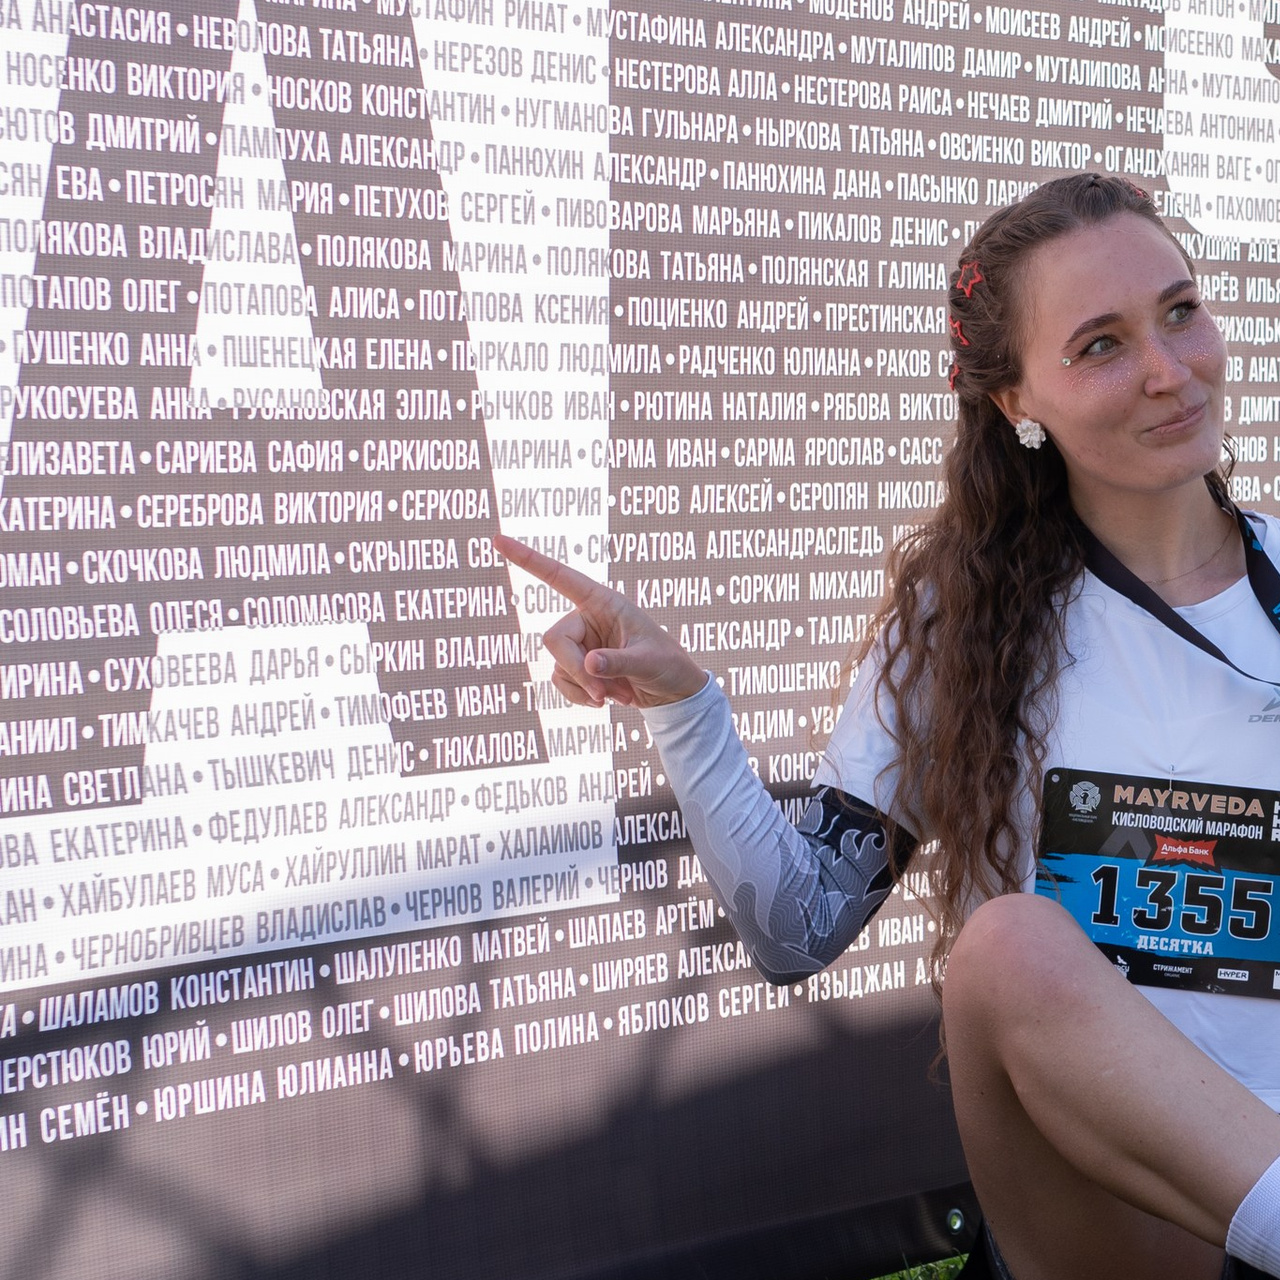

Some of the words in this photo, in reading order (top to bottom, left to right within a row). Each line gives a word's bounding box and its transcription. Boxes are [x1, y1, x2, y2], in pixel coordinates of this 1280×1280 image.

[434, 41, 522, 78] НЕРЕЗОВ
[530, 52, 597, 85] ДЕНИС
[354, 186, 450, 220] ПЕТУХОВ
[460, 190, 536, 226] СЕРГЕЙ
[761, 254, 869, 288] ПОЛЯНСКАЯ
[878, 260, 947, 290] ГАЛИНА
[634, 392, 712, 421] РЮТИНА
[723, 393, 805, 421] НАТАЛИЯ
[156, 441, 257, 473] САРИЕВА
[267, 440, 343, 472] САФИЯ
[363, 439, 480, 471] САРКИСОВА
[492, 438, 572, 470] МАРИНА
[620, 486, 680, 515] СЕРОВ
[691, 478, 772, 514] АЛЕКСЕЙ
[208, 800, 328, 845] ФЕДУЛАЕВ
[339, 785, 456, 832] АЛЕКСАНДР
[1113, 785, 1265, 817] MAYRVEDA
[1112, 811, 1203, 834] КИСЛОВОДСКИЙ
[1206, 821, 1263, 839] МАРАФОН
[284, 839, 406, 889] ХАЙРУЛЛИН
[416, 834, 481, 872] МАРАТ
[1161, 844, 1188, 854] Альфа
[1189, 847, 1209, 855] Банк
[1091, 864, 1273, 941] 1355
[1137, 935, 1214, 955] ДЕСЯТКА
[1153, 964, 1193, 974] СТРИЖАМЕНТ
[231, 1007, 312, 1055] ШИЛОВ
[322, 999, 375, 1038] ОЛЕГ
[154, 1067, 266, 1120] ЮРШИНА
[277, 1047, 394, 1097] ЮЛИАННА
